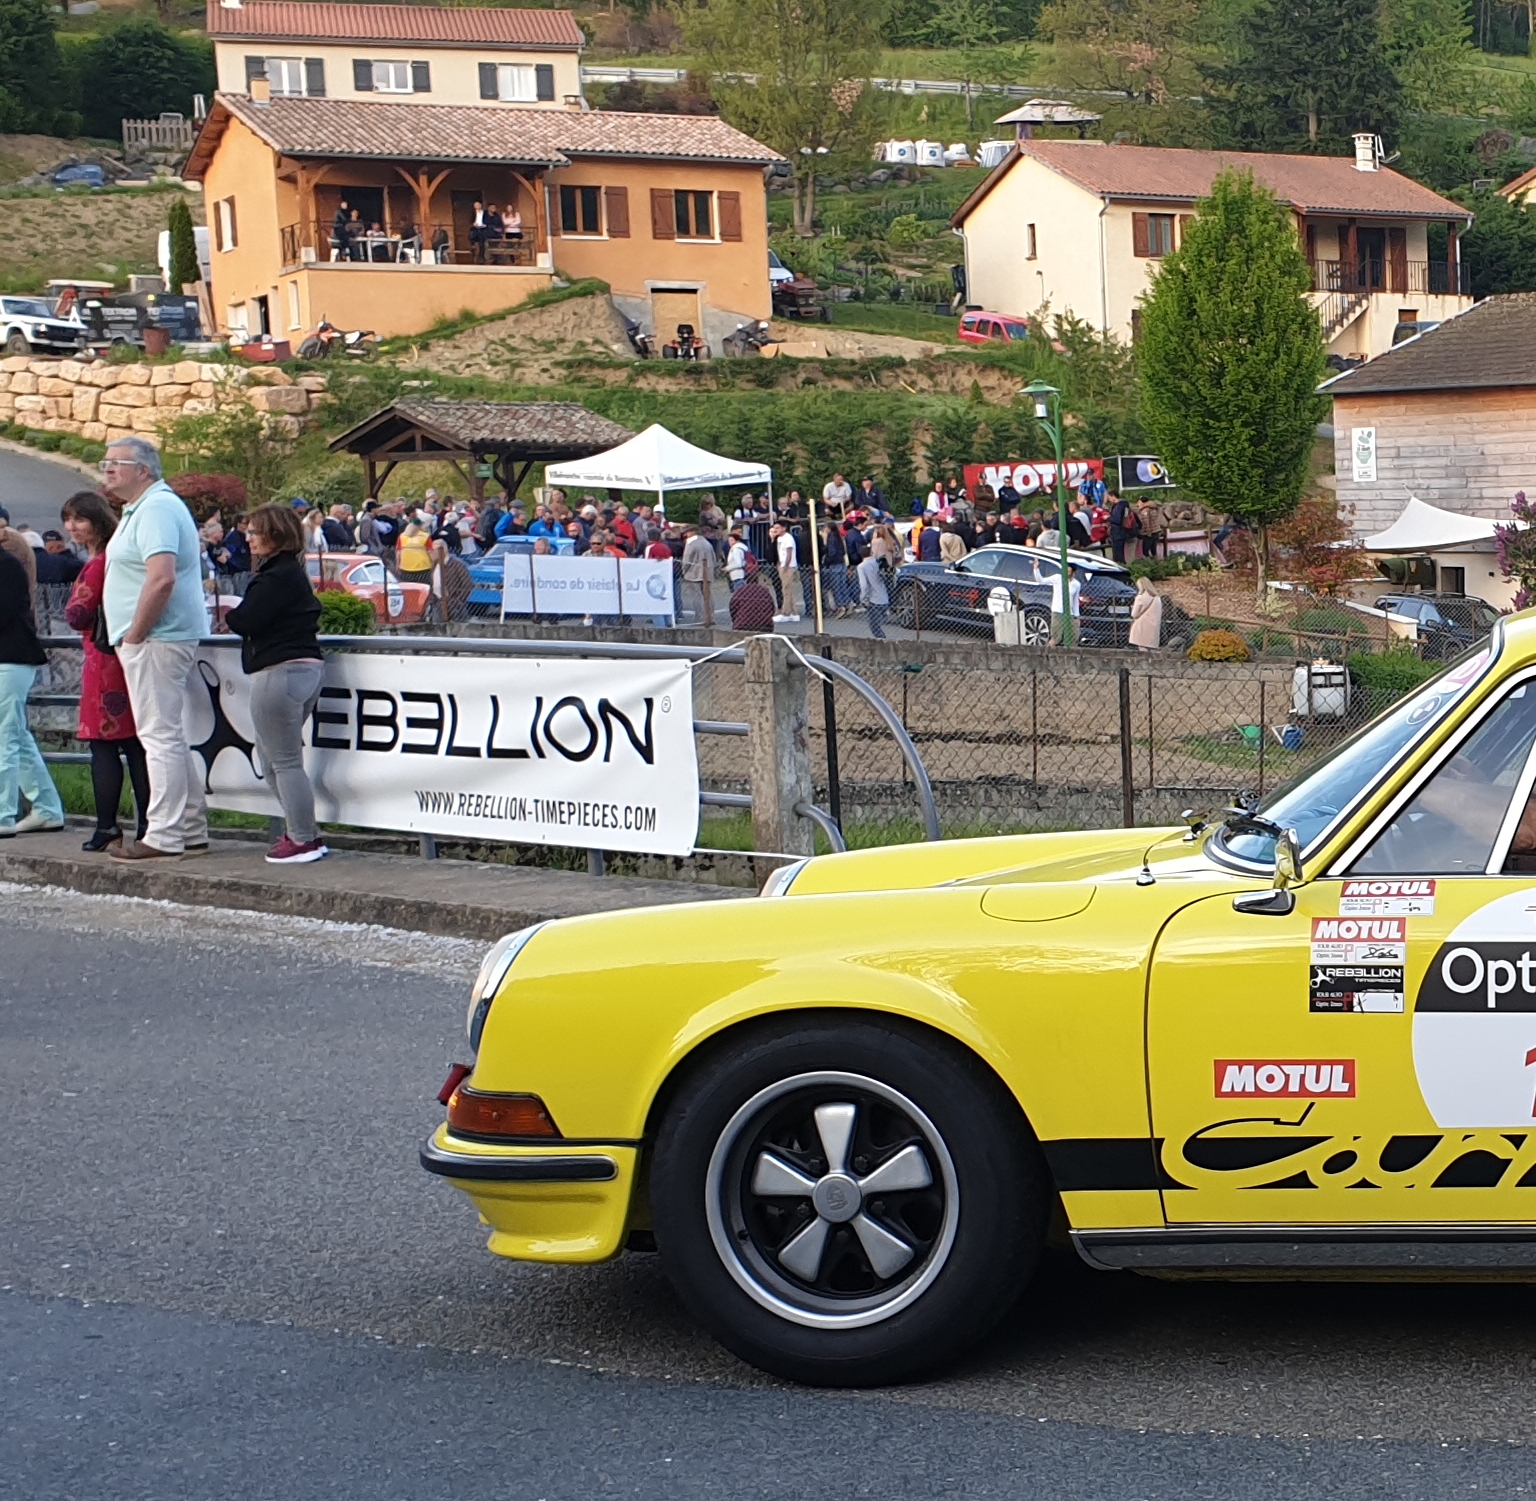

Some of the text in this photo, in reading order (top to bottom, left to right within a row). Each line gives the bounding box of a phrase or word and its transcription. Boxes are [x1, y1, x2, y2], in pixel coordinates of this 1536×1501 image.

[300, 685, 655, 765] EBELLION
[415, 790, 657, 832] WWW.REBELLION-TIMEPIECES.COM
[1344, 882, 1431, 895] MOTUL
[1315, 920, 1402, 939] MOTUL
[1326, 968, 1401, 977] REBELLION
[1221, 1065, 1350, 1092] MOTUL
